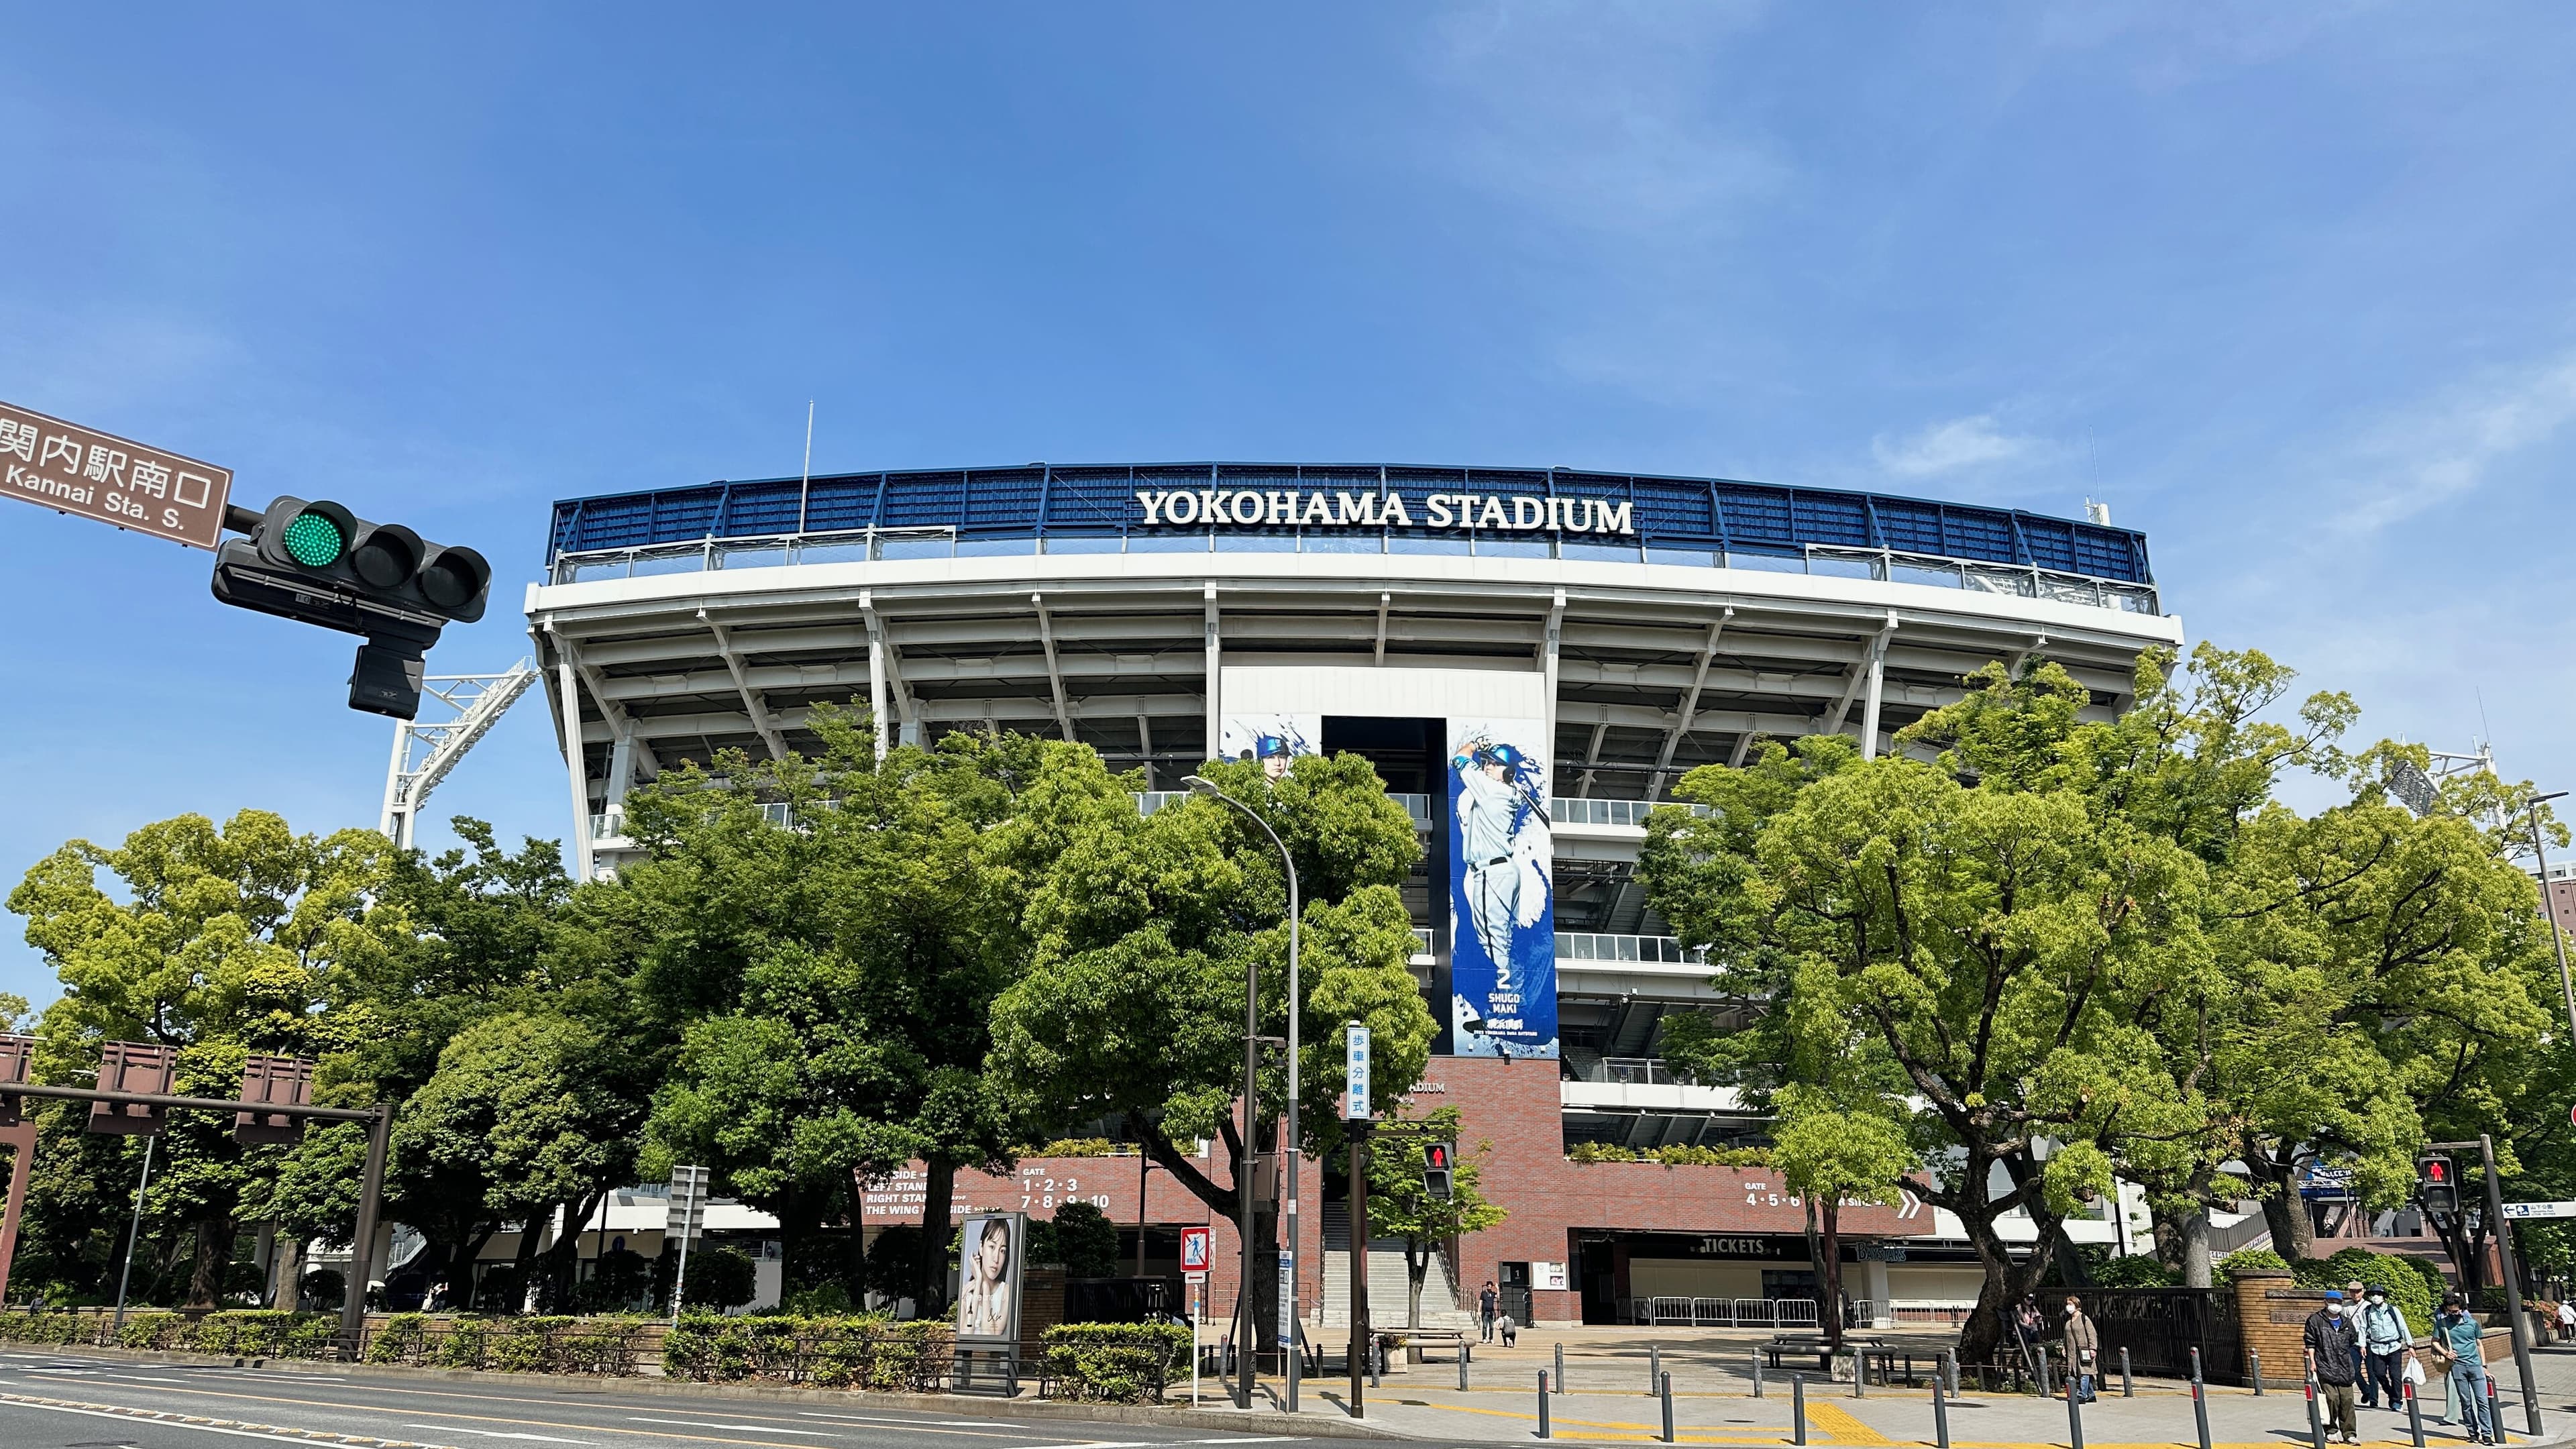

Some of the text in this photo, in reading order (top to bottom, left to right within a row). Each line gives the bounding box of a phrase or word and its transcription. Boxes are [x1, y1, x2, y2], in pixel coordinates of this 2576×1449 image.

[0, 418, 211, 509] 関内駅南口
[5, 464, 184, 530] Kannai Sta. S.
[1136, 490, 1634, 534] YOKOHAMA STADIUM
[1497, 969, 1511, 989] 2
[1489, 993, 1520, 1004] SHUGO
[1493, 1004, 1517, 1014] MAKI
[1352, 1034, 1364, 1112] 歩車分離式
[1408, 1083, 1445, 1093] ADIUM
[866, 1193, 900, 1203] RIGHT
[865, 1205, 886, 1215] THE
[889, 1205, 919, 1215] WING
[1703, 1238, 1764, 1254] TICKETS
